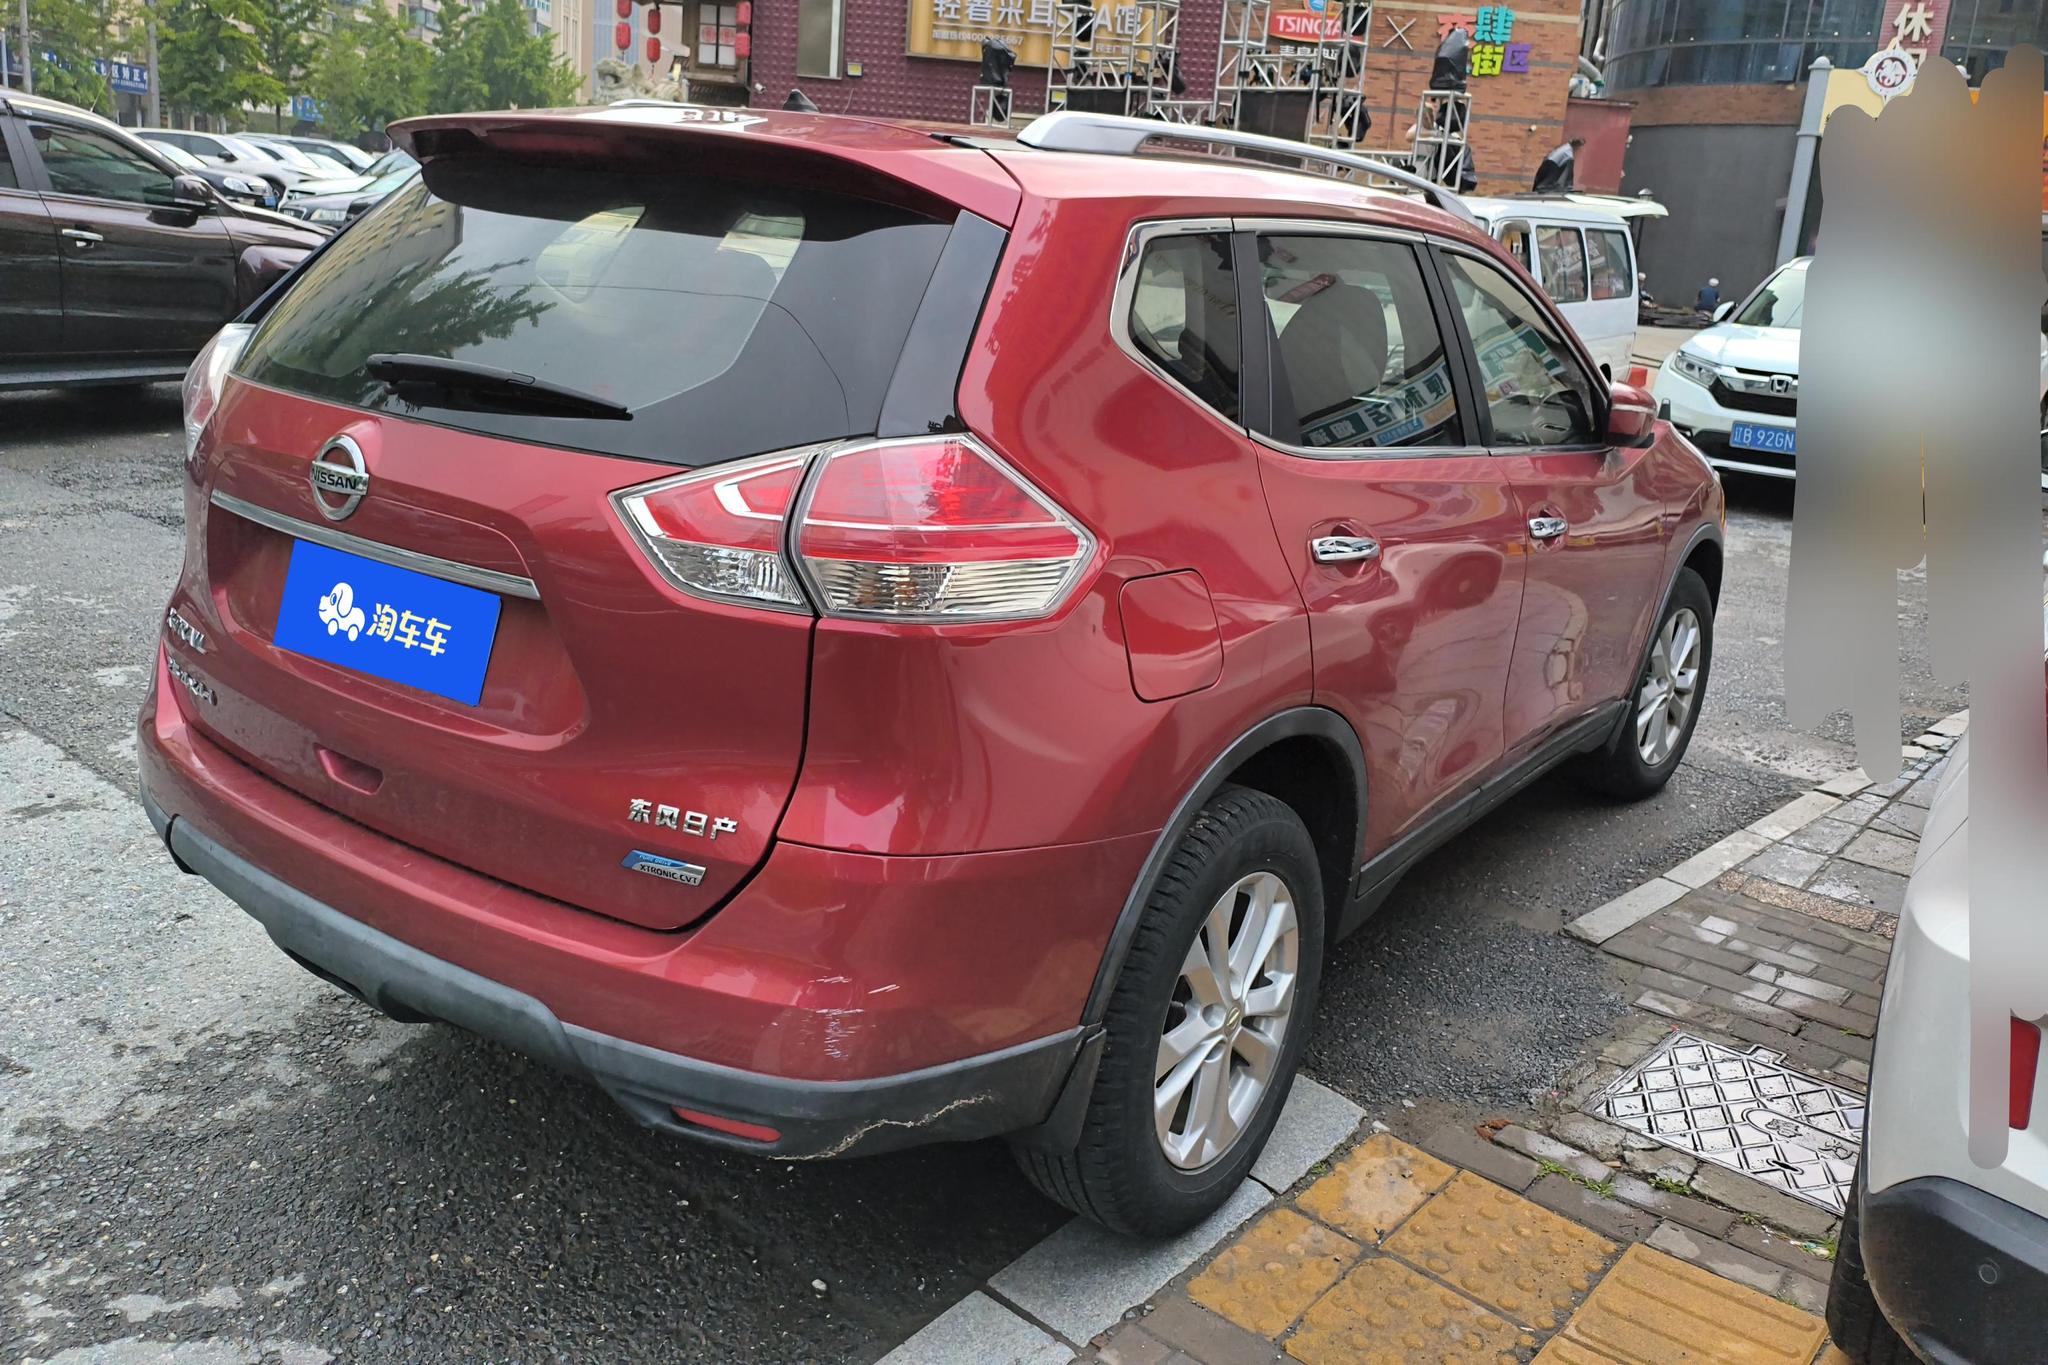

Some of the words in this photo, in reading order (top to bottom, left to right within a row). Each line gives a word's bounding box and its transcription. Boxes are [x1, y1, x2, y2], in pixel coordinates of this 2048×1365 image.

[1276, 15, 1348, 37] TSINGTA
[313, 466, 357, 490] NISSAN
[627, 798, 739, 841] 东风日产
[640, 863, 678, 880] XTRONIC
[680, 874, 699, 885] CVT
